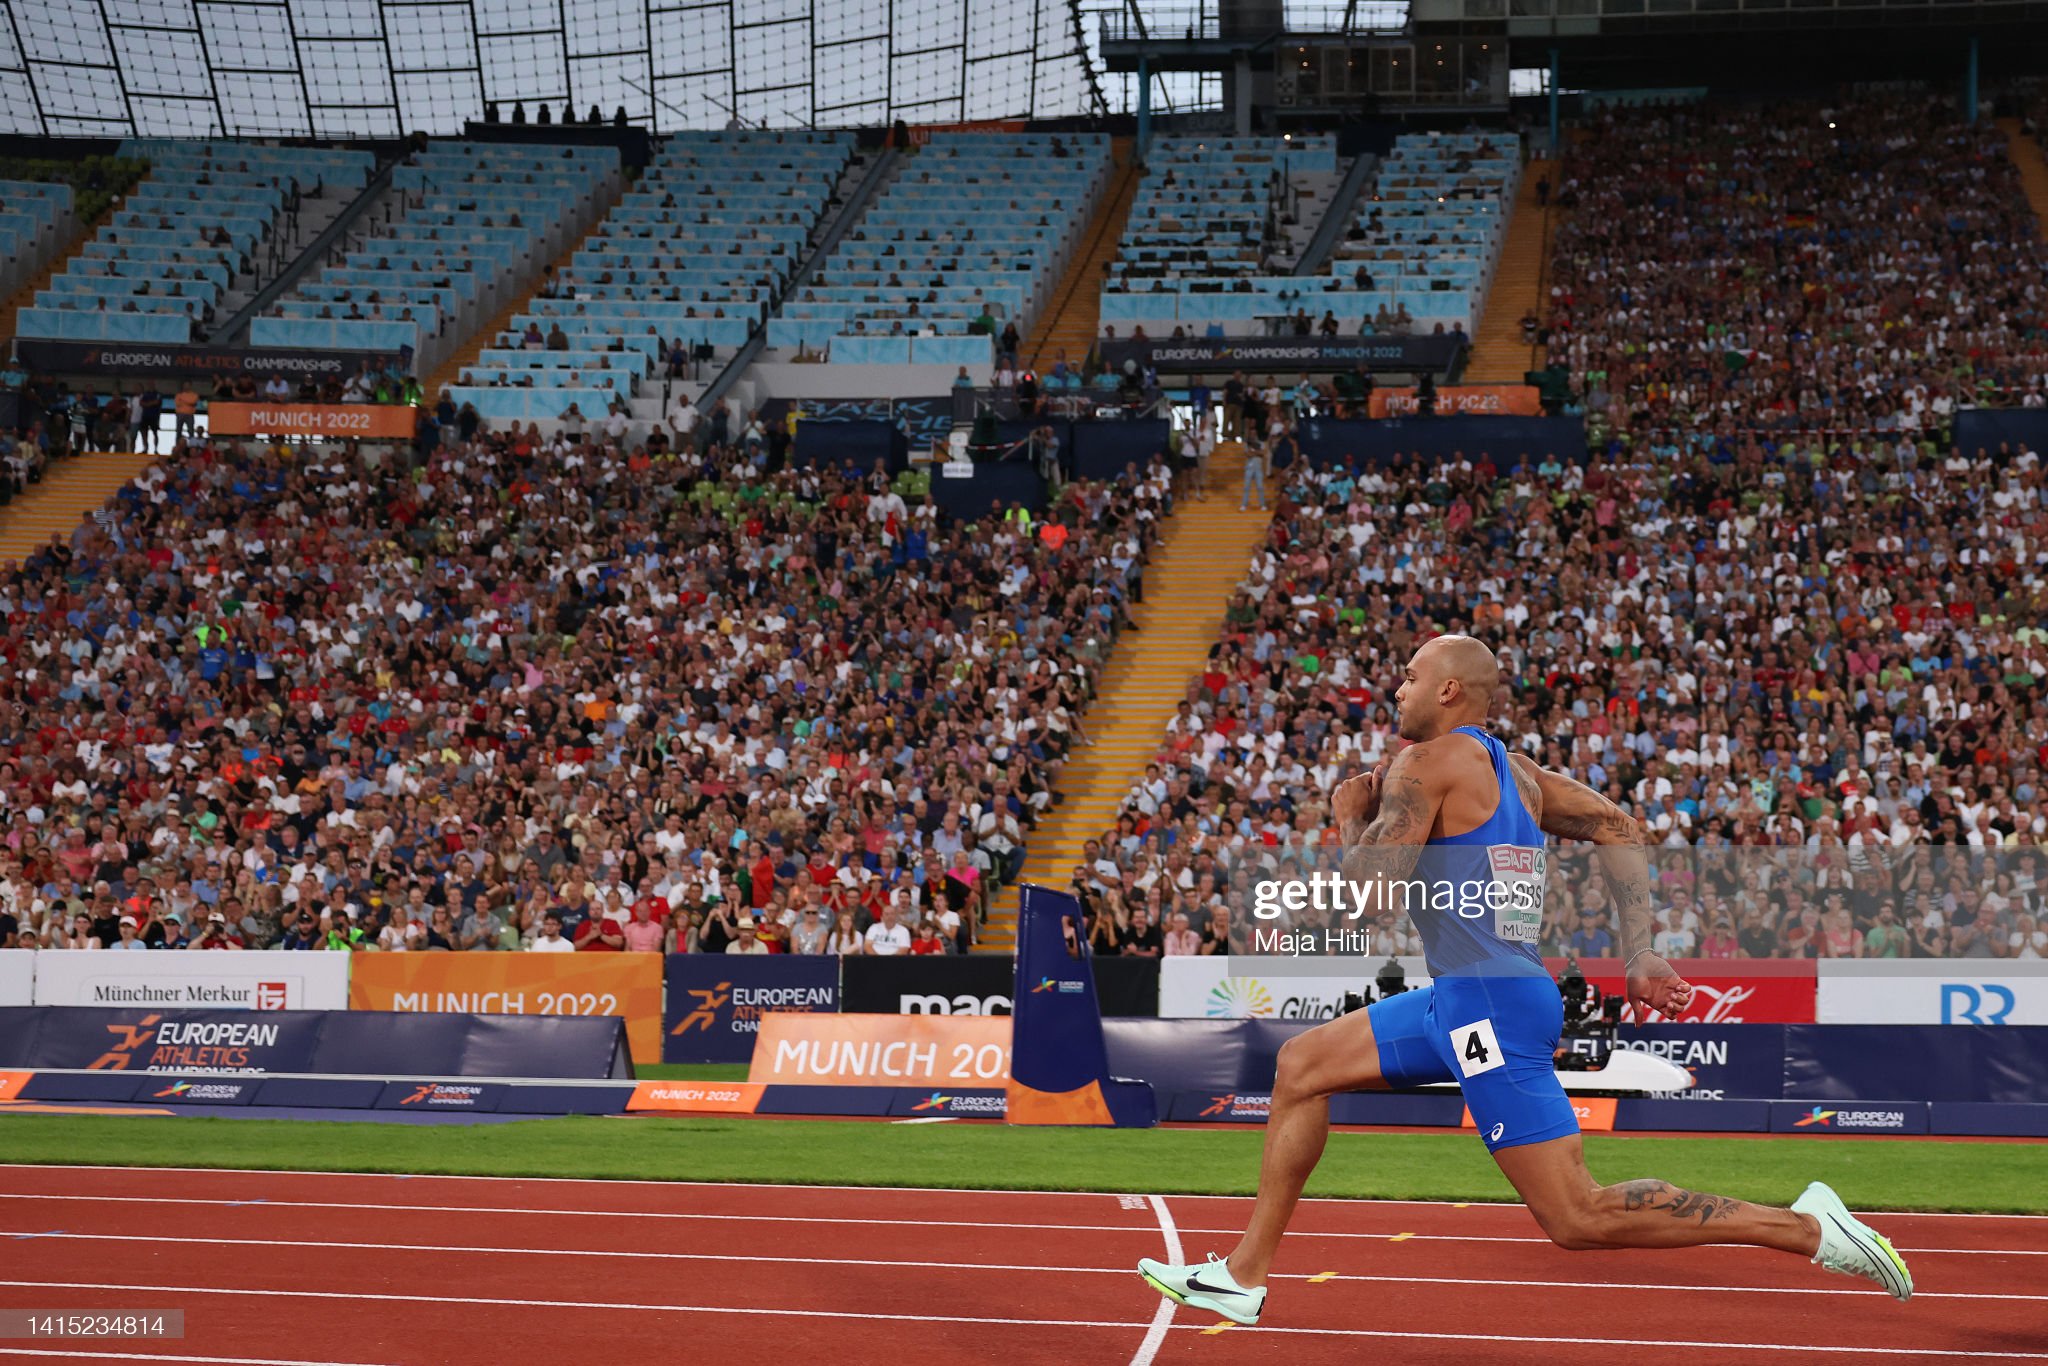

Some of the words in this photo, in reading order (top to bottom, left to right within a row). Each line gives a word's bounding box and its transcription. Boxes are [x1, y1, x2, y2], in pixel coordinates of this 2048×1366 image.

[101, 351, 171, 367] EUROPEAN
[175, 355, 241, 369] ATHLETICS
[244, 357, 342, 372] CHAMPIONSHIPS
[1152, 348, 1213, 361] EUROPEAN
[1233, 347, 1320, 360] CHAMPIONSHIPS
[1322, 347, 1370, 358] MUNICH
[1373, 347, 1403, 358] 2022
[251, 411, 321, 426] MUNICH
[327, 412, 371, 428] 2022
[93, 984, 181, 1001] Münchner
[187, 985, 251, 1001] Merkur
[733, 987, 832, 1005] EUROPEAN
[393, 992, 524, 1014] MUNICH
[537, 993, 617, 1016] 2022
[157, 1022, 279, 1046] EUROPEAN
[1465, 1030, 1488, 1064] 4
[150, 1047, 250, 1066] ATHLETICS
[774, 1039, 937, 1077] MUNICH
[949, 1043, 1011, 1079] 20
[650, 1089, 705, 1100] MUNICH
[706, 1091, 741, 1101] 2022
[1837, 1111, 1904, 1121] EUROPEAN
